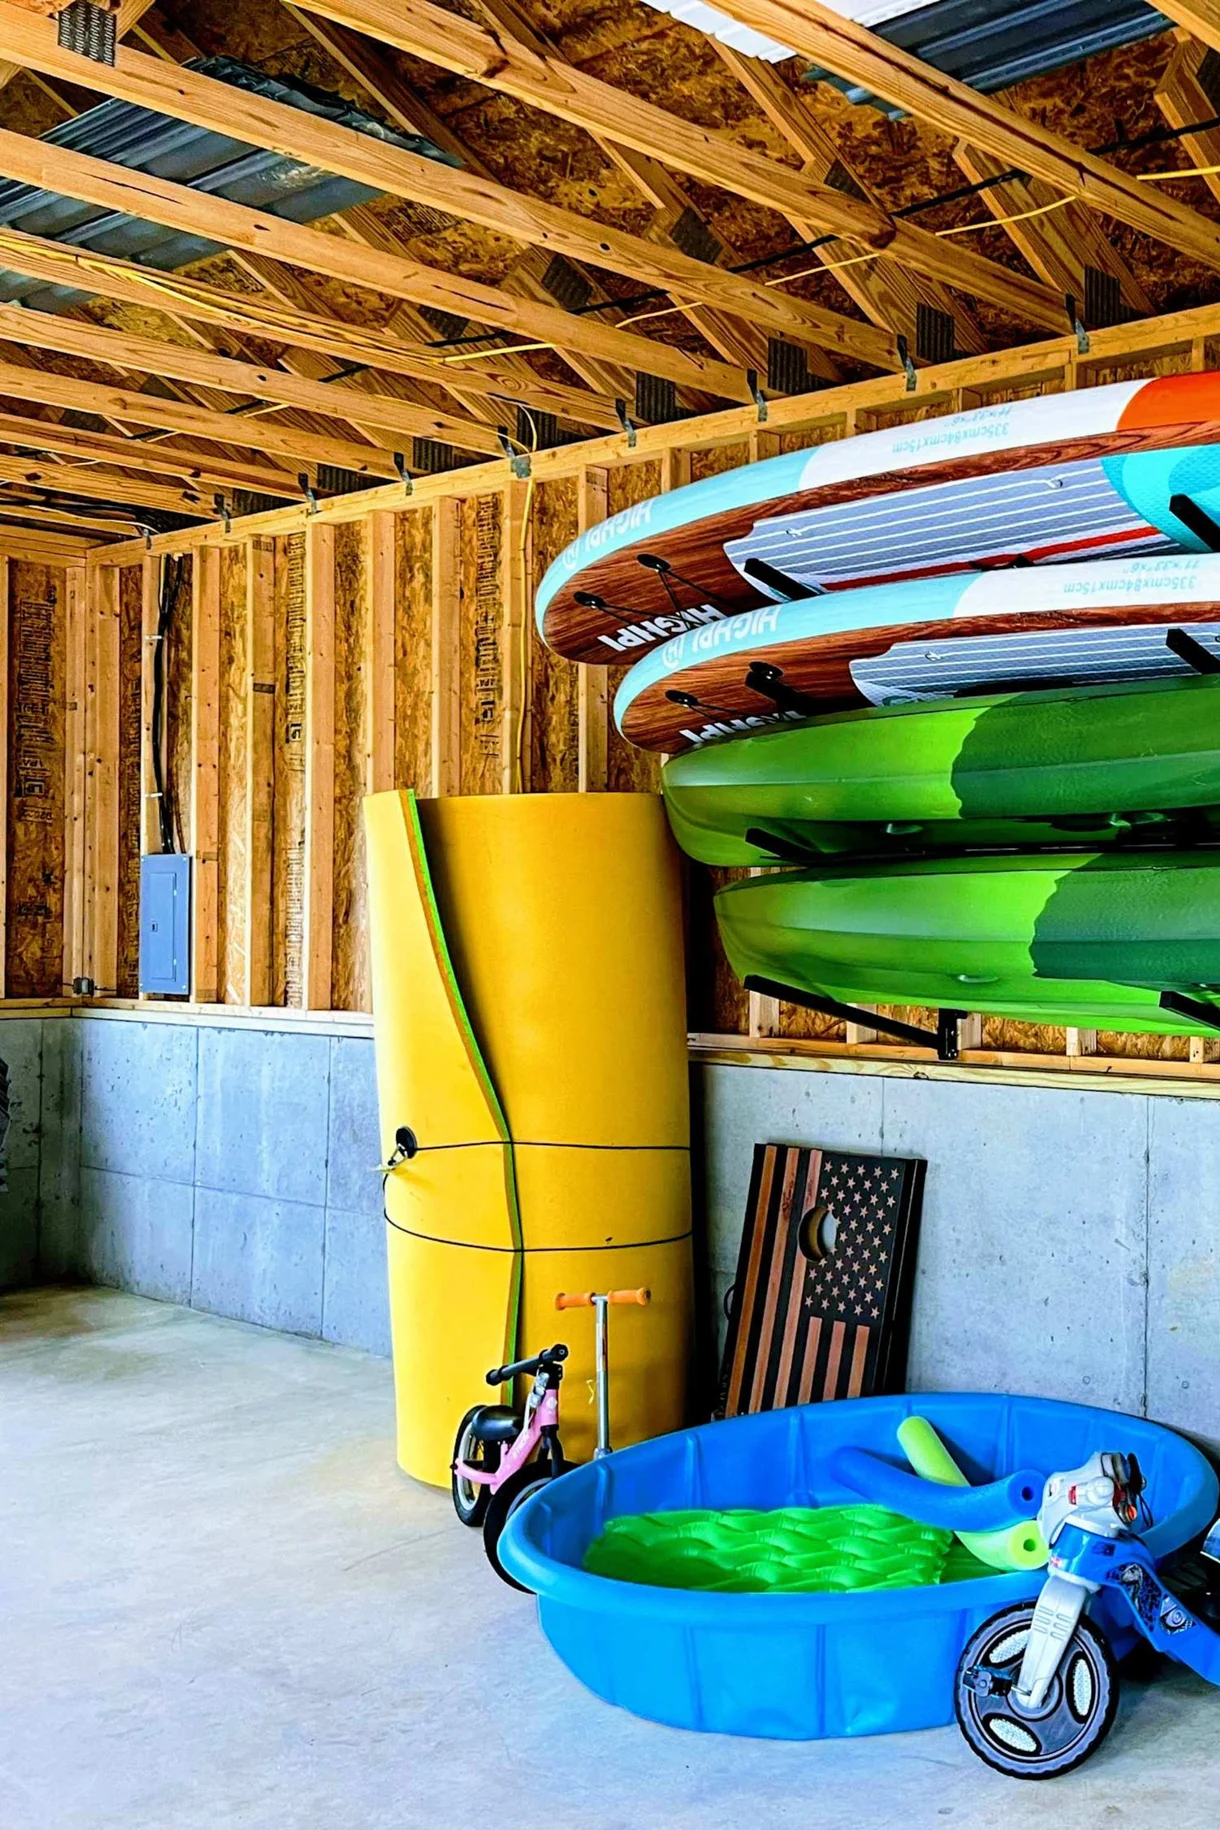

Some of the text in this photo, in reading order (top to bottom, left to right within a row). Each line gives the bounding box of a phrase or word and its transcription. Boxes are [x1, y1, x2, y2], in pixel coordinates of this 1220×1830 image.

[585, 499, 654, 552] HIGHPI
[1063, 576, 1197, 595] 335cmx84cmx15cm
[692, 606, 781, 653] HIGHPI
